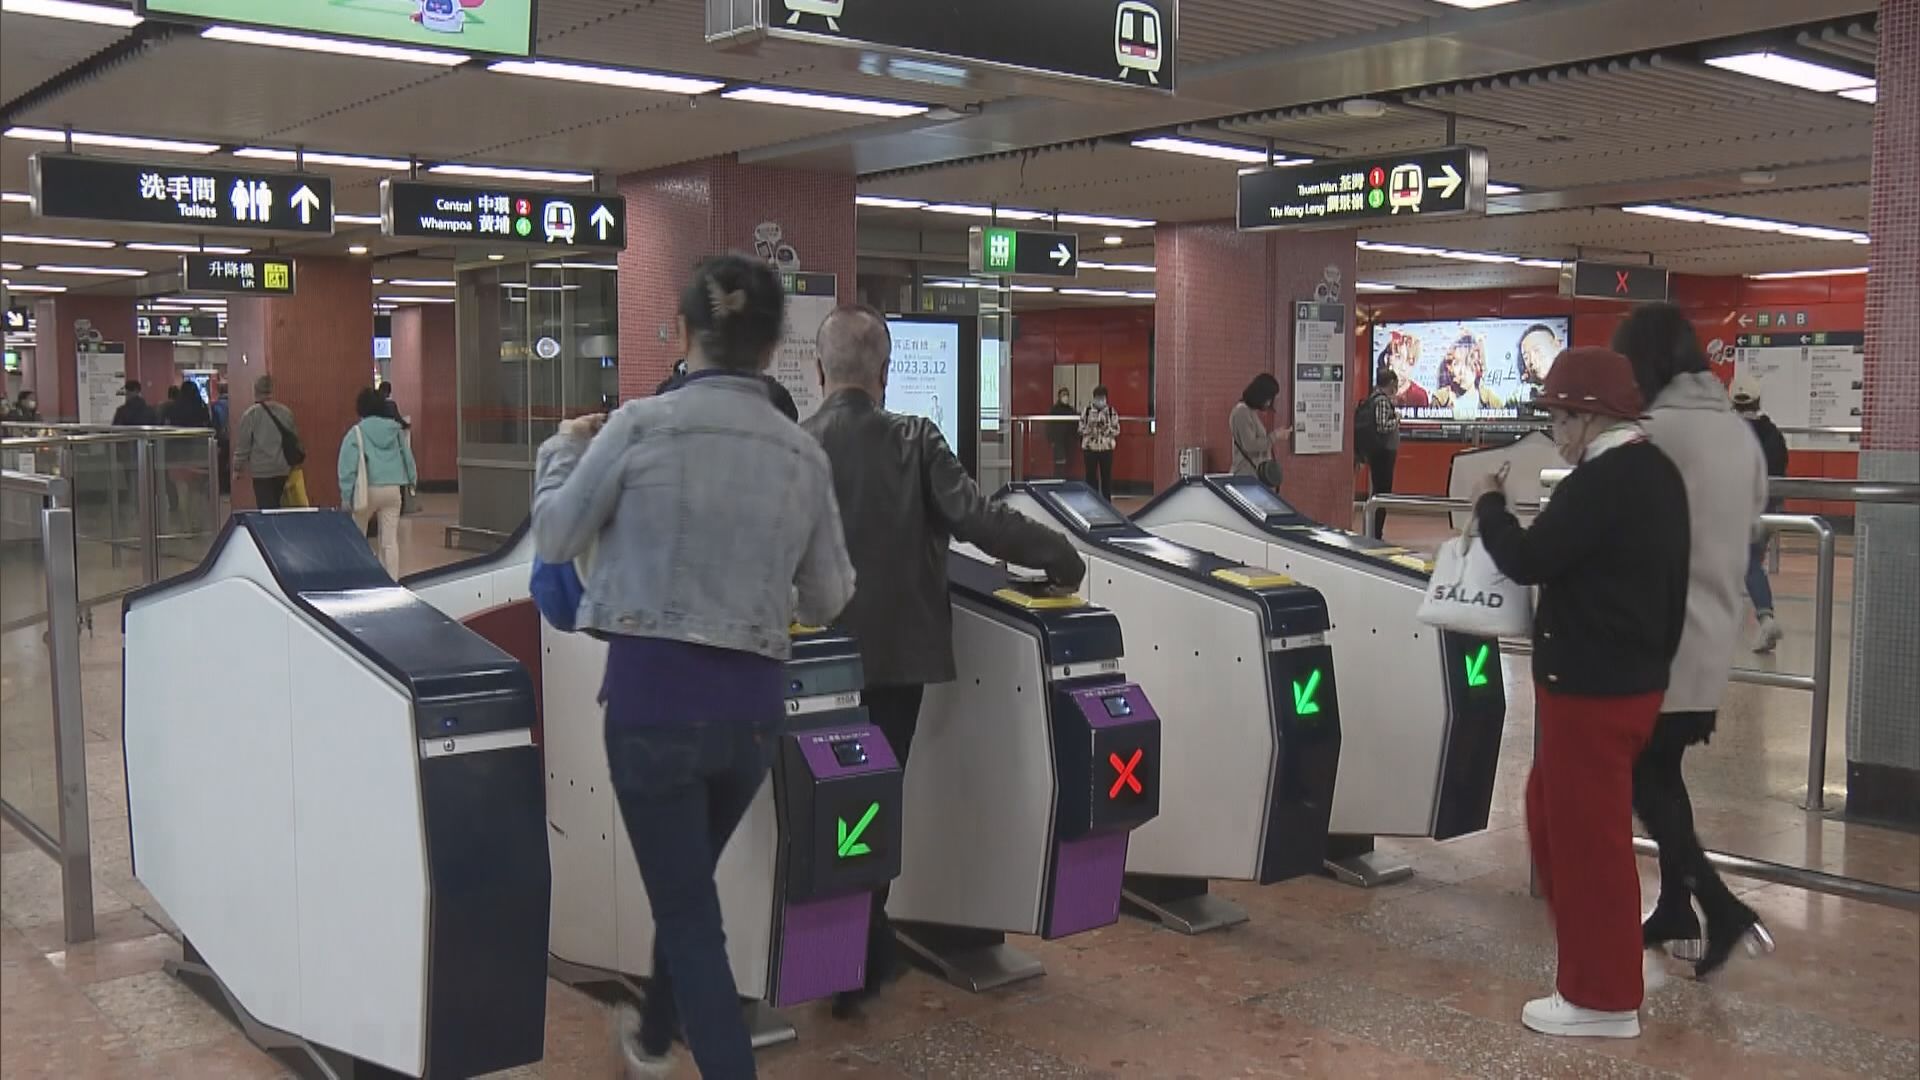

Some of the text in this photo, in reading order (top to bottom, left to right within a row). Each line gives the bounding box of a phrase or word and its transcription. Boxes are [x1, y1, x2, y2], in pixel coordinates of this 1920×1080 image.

[141, 173, 216, 203] 洗手間
[1297, 184, 1320, 196] Tsuen
[1321, 182, 1338, 193] Wan
[178, 203, 217, 218] Toilets
[436, 199, 472, 213] Central
[1270, 206, 1283, 218] Tiu
[1284, 205, 1304, 218] Keng
[1305, 203, 1325, 216] Leng
[421, 216, 472, 232] Whampoa
[990, 257, 1009, 267] EXIT
[209, 261, 255, 279] 升降機
[242, 279, 255, 288] Lift
[1777, 313, 1787, 325] A
[1796, 313, 1806, 325] B
[890, 361, 946, 374] 2023.3.12
[1433, 585, 1504, 608] SALAD
